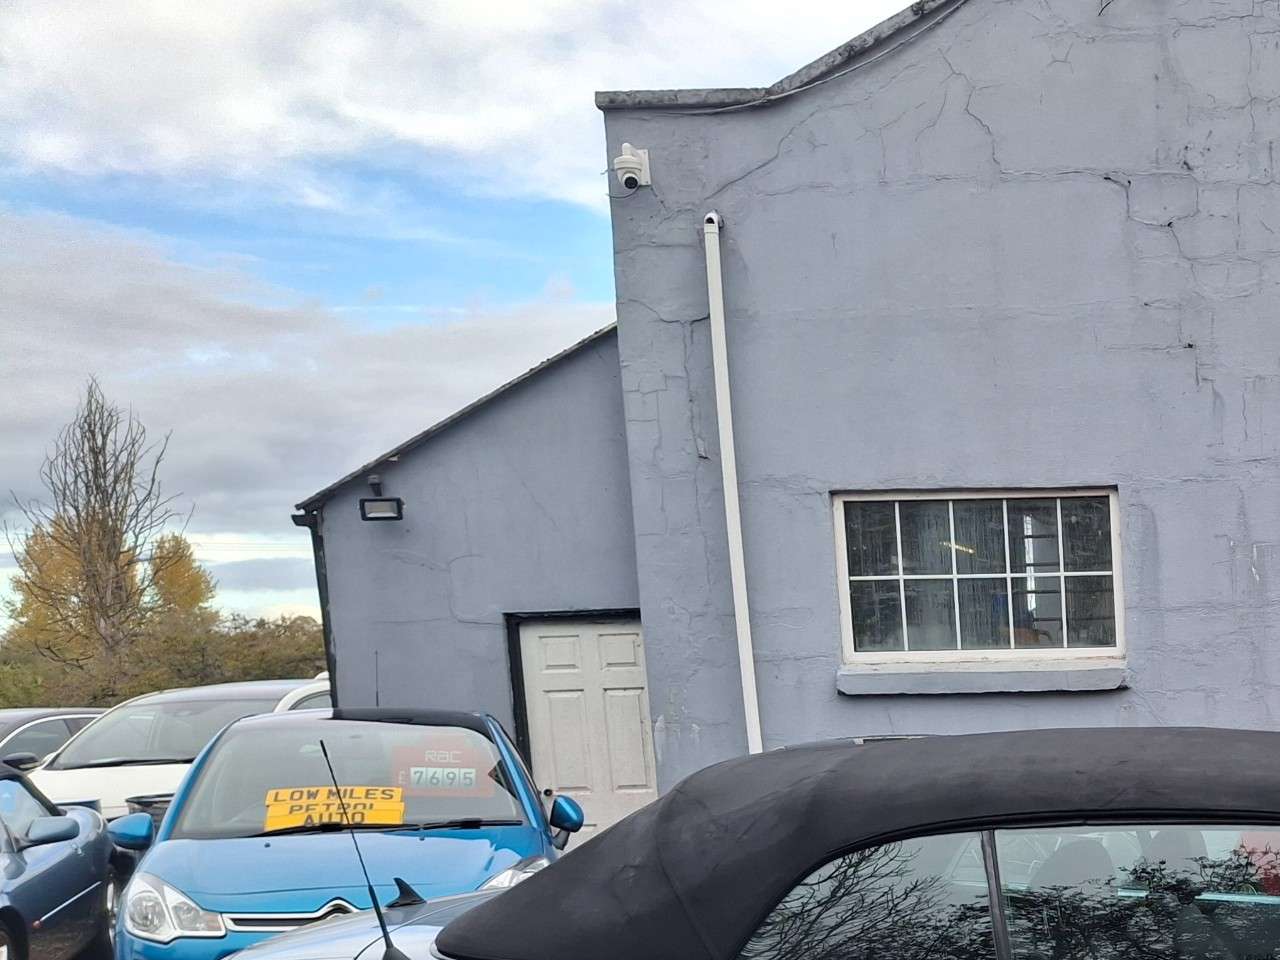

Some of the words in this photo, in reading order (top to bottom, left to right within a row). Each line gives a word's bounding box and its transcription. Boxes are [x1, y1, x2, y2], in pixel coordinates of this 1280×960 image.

[273, 789, 320, 802] LOW
[326, 788, 395, 801] MILES
[304, 812, 365, 826] AUTO
